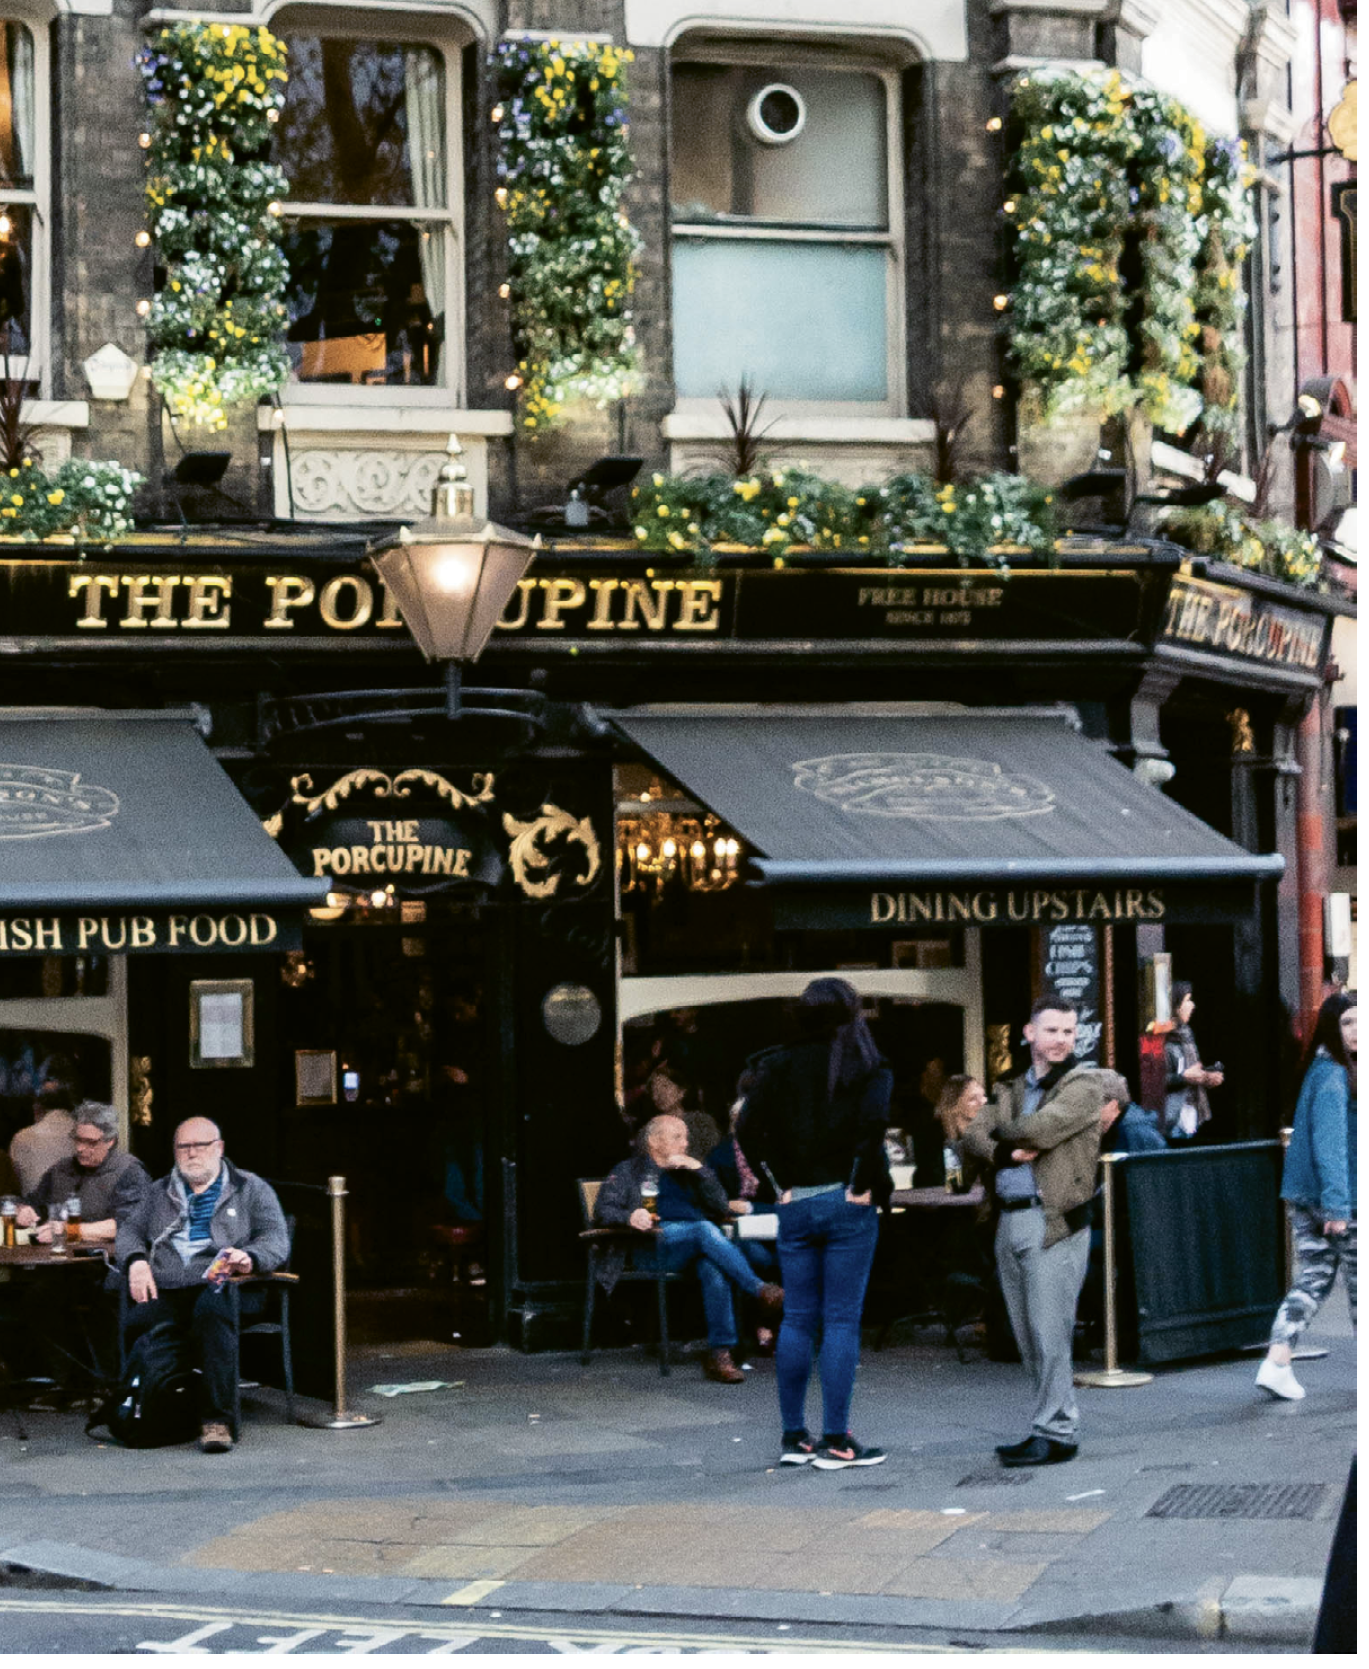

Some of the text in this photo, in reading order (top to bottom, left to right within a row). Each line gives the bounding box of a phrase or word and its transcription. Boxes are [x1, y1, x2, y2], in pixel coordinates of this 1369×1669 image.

[68, 574, 723, 630] THE POUPINE
[857, 588, 1003, 606] FREE HOUSE
[1164, 588, 1214, 643] THE
[367, 820, 420, 842] THE
[312, 845, 472, 877] PORCUPINE
[870, 889, 1166, 923] DINING UPSTAIRS
[77, 916, 156, 948] PUB
[167, 913, 277, 946] FOOD
